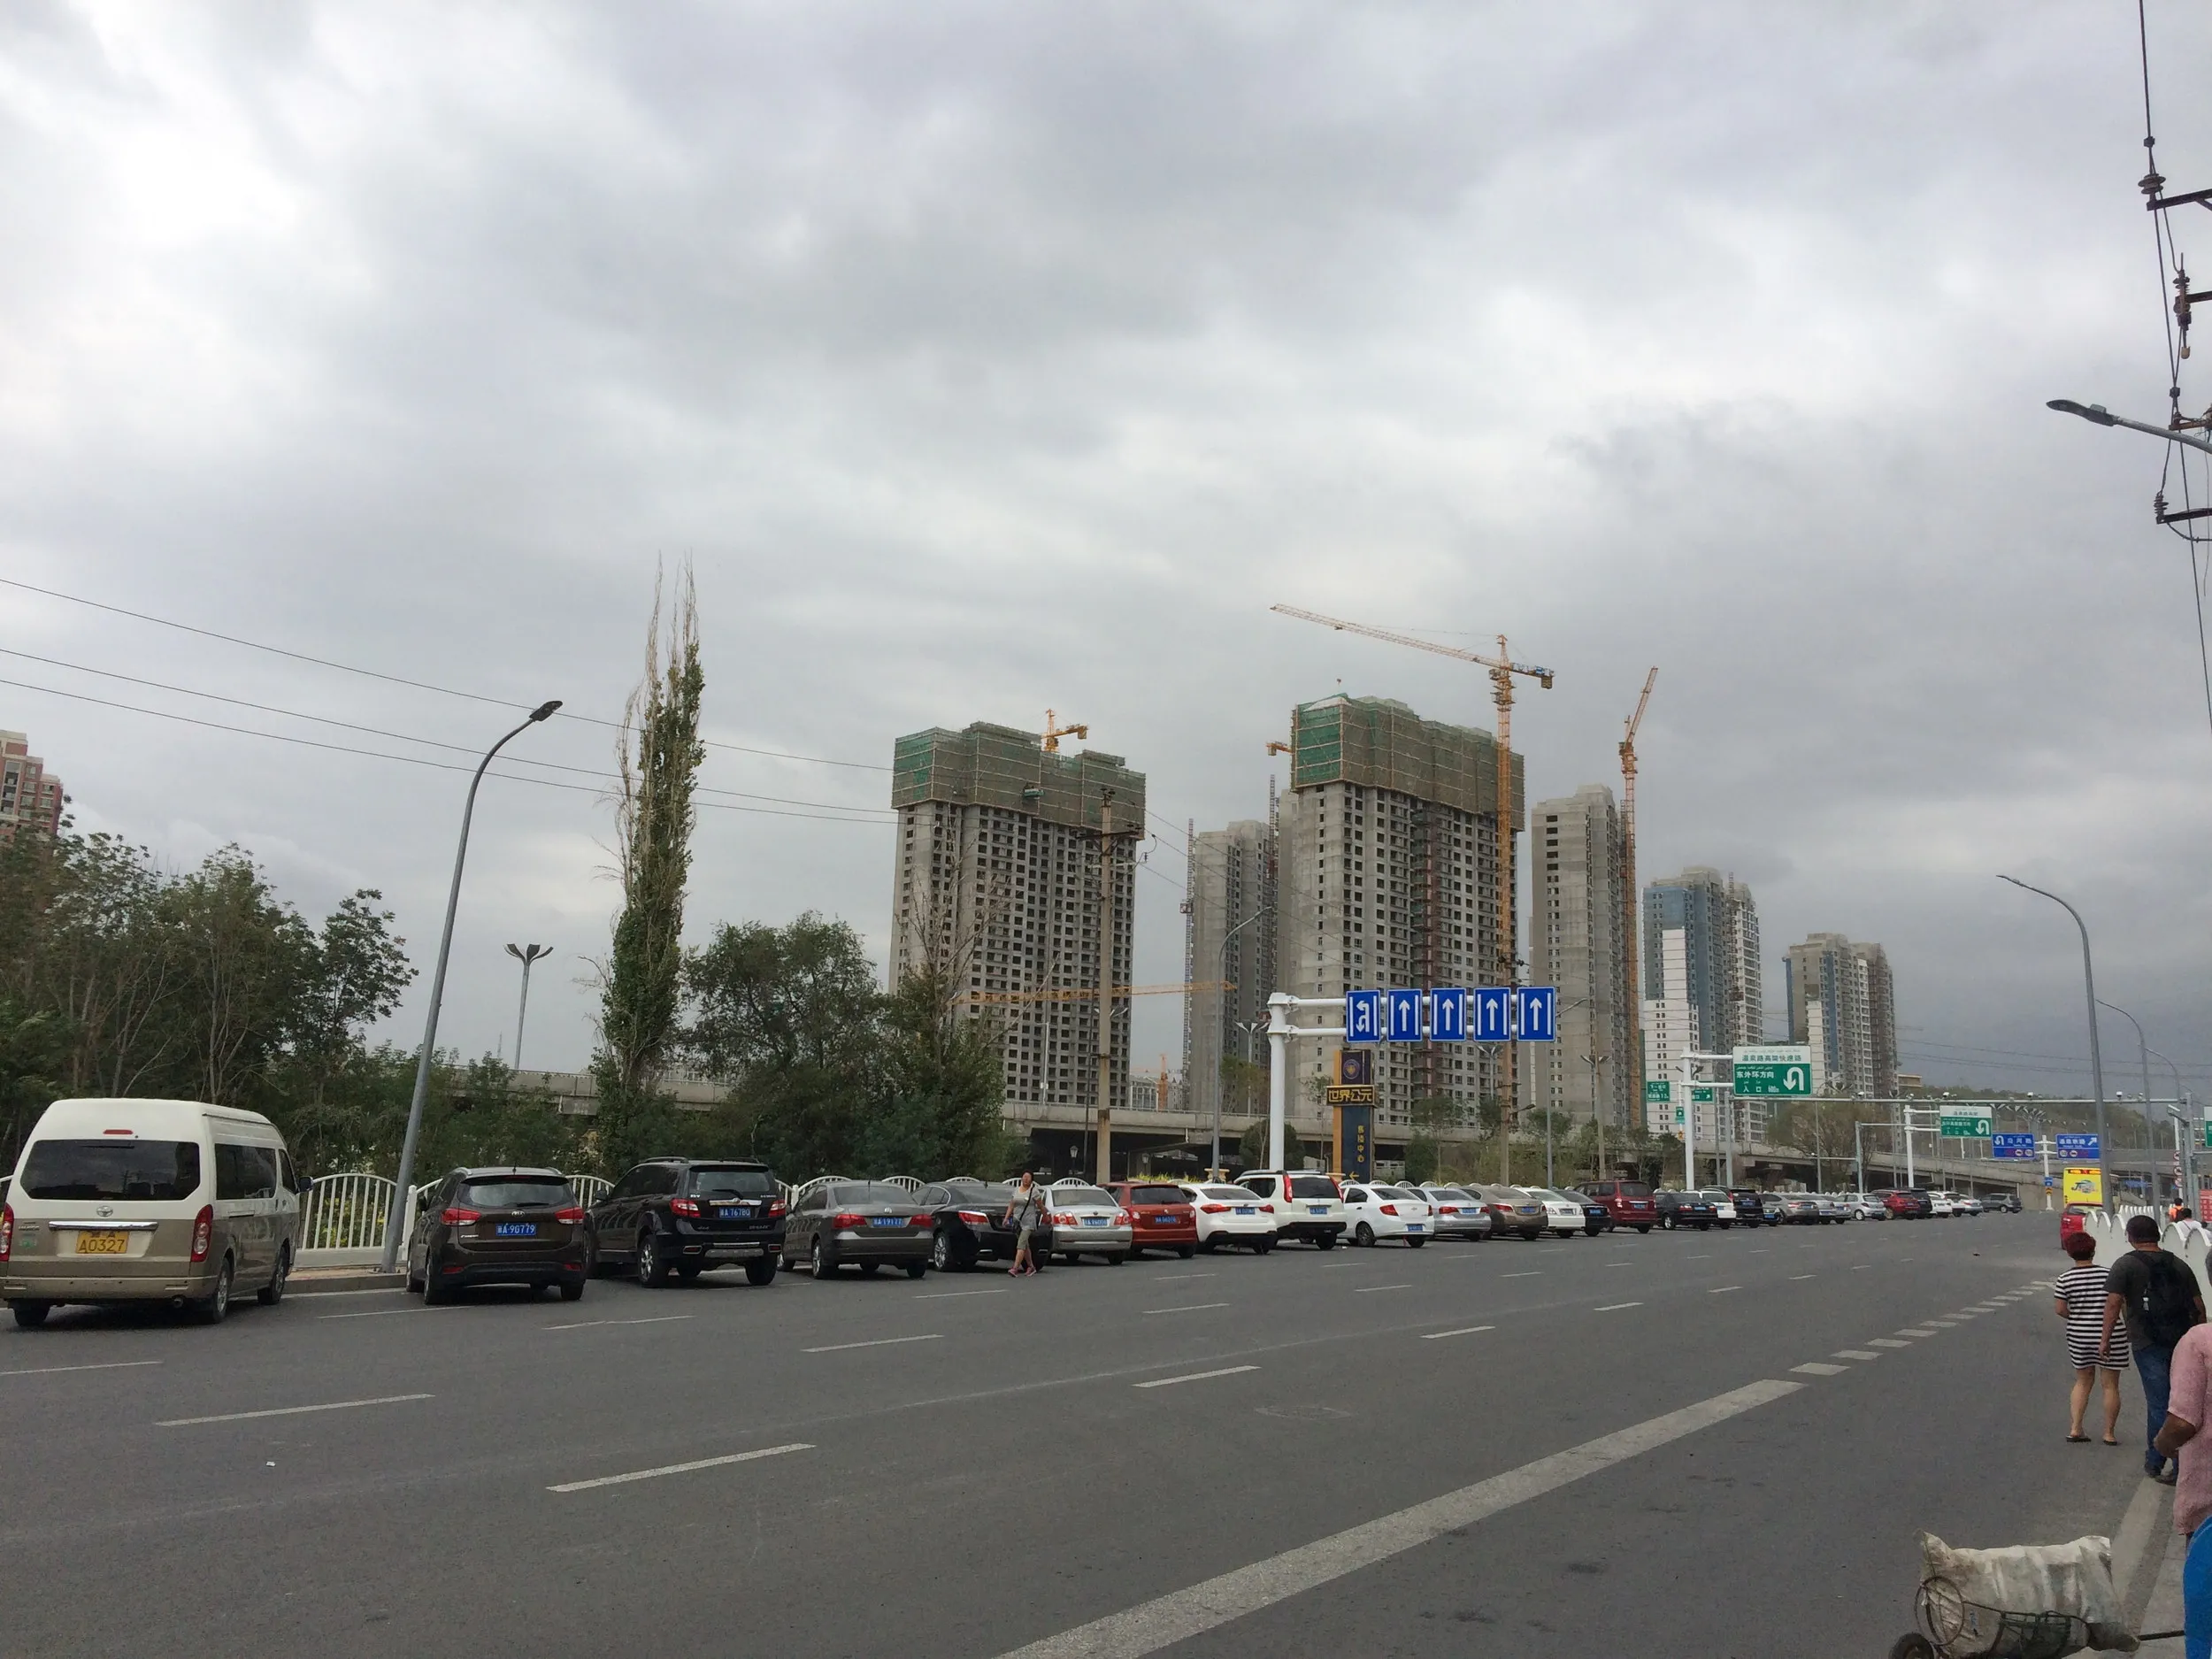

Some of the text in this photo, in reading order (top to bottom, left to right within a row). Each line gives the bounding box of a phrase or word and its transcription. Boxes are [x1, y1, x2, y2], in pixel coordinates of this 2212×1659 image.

[1328, 1088, 1372, 1102] 世界公元
[78, 1239, 125, 1253] A0327
